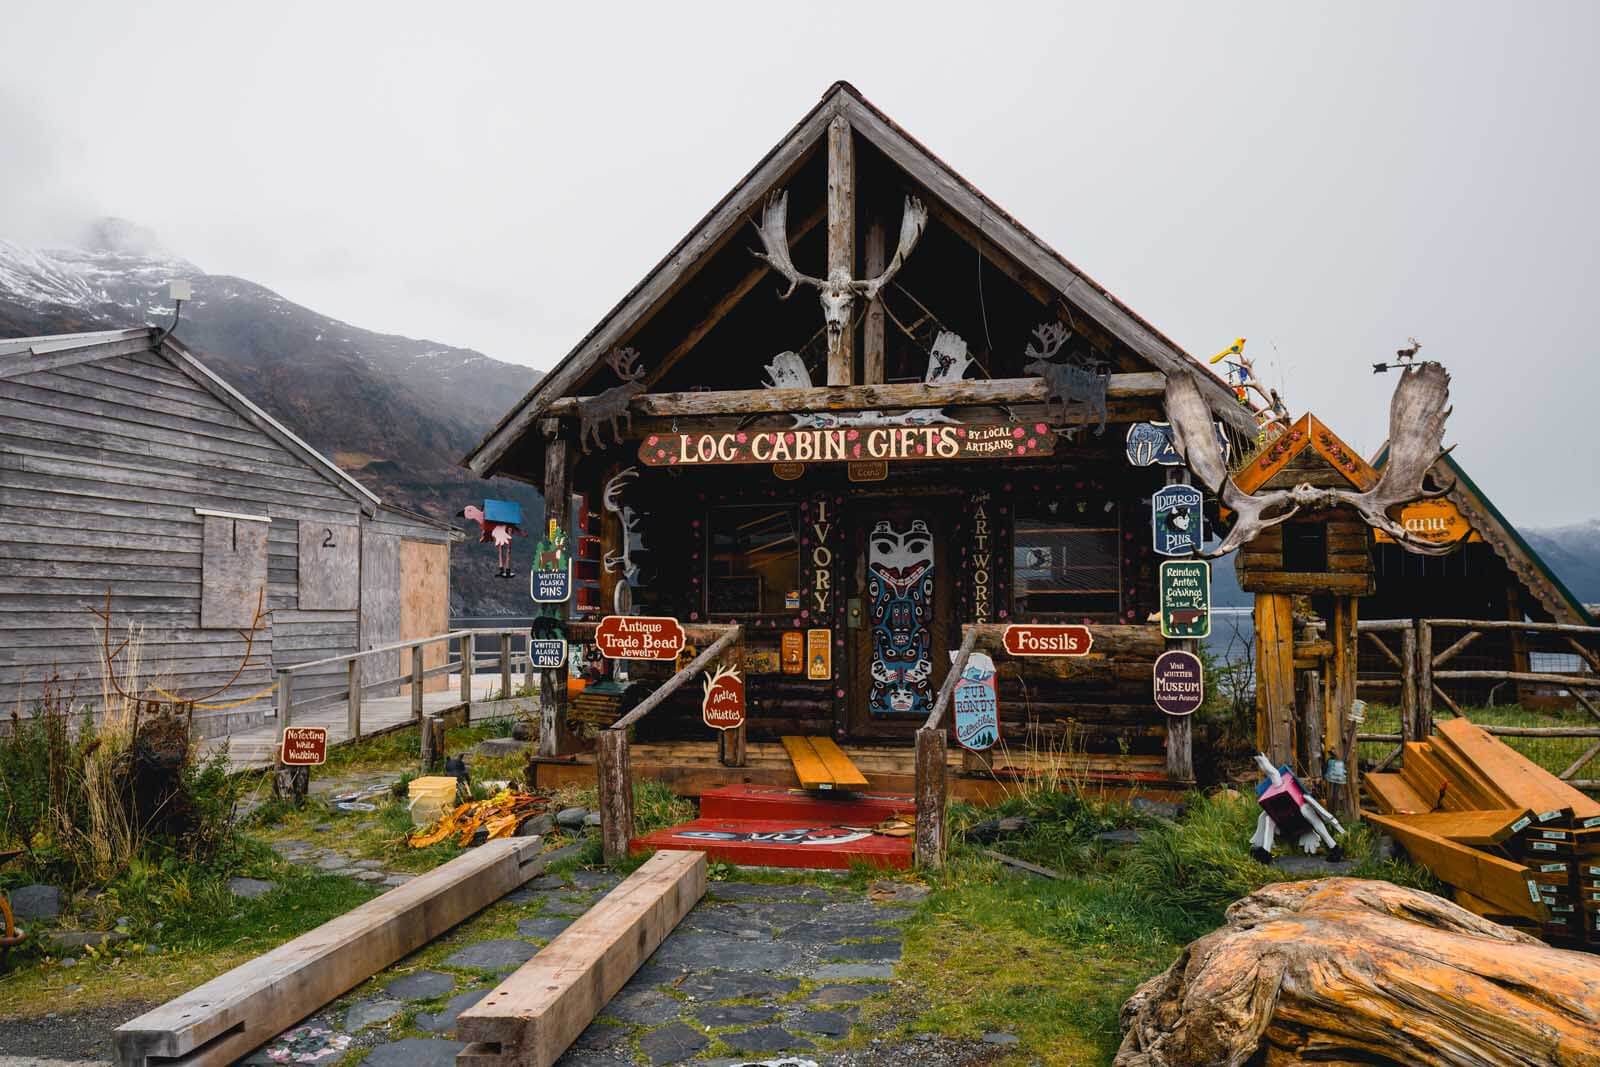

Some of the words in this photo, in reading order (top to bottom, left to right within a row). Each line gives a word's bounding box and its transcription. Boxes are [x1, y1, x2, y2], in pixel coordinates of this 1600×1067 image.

[968, 430, 979, 440] BY
[983, 427, 1012, 438] LOCAL
[679, 434, 736, 463] LOG
[751, 430, 846, 461] CABIN
[867, 427, 959, 458] GIFTS
[965, 439, 1013, 452] ARTISANS
[1156, 494, 1200, 511] IDITAROD
[322, 527, 336, 548] 2
[1165, 533, 1192, 553] PINS
[812, 501, 832, 613] IVORY
[1166, 567, 1201, 577] Reindeer
[1172, 578, 1199, 587] Antler
[540, 587, 562, 597] PINS
[618, 618, 663, 634] Antique
[603, 634, 640, 648] Trade
[642, 634, 678, 649] Bead
[1017, 631, 1078, 650] Fossils
[620, 648, 660, 658] Jewelry
[538, 656, 560, 666] PINS
[1169, 662, 1185, 670] Visit
[963, 685, 987, 699] FUR
[956, 700, 996, 713] RONDY
[706, 707, 740, 720] Whistles
[287, 730, 297, 739] No
[296, 741, 316, 749] While
[289, 749, 320, 762] Walking
